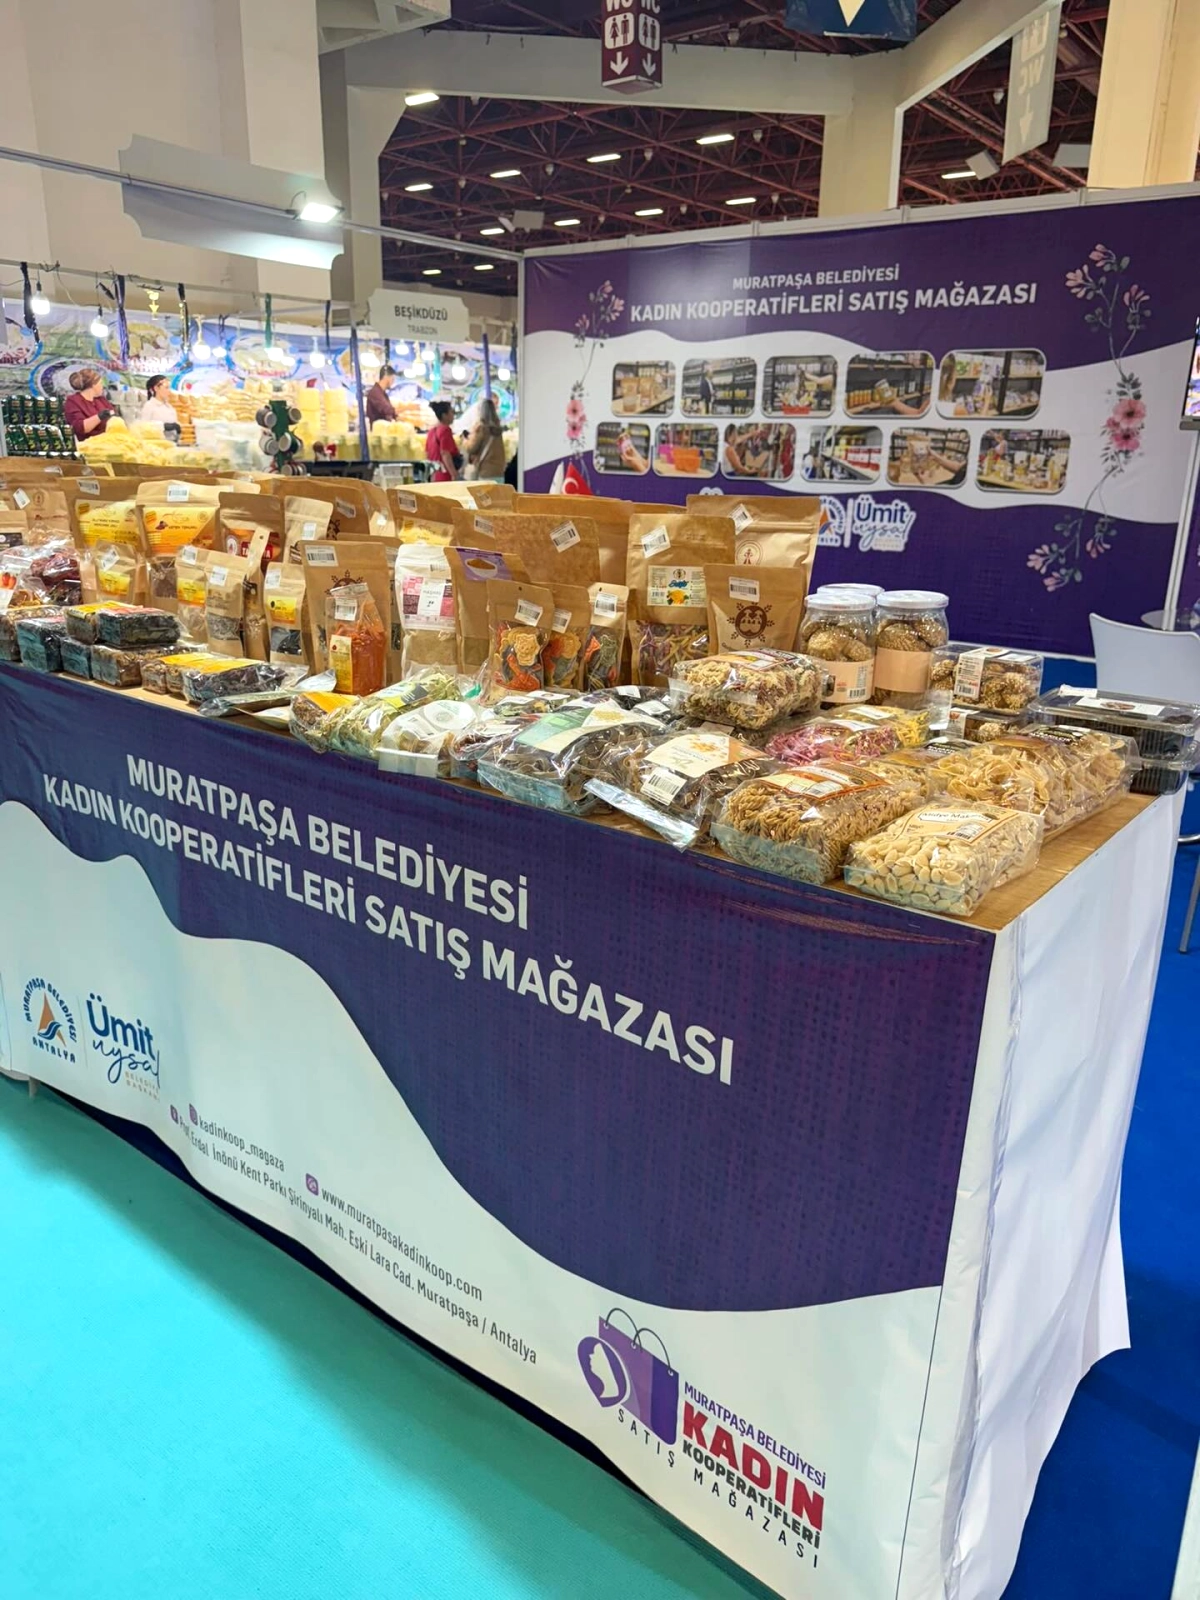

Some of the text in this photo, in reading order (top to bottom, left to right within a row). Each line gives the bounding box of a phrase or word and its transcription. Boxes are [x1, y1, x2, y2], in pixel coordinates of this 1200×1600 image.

[394, 304, 448, 321] BEŞİKDÜZÜ
[630, 281, 1037, 322] KADIN KOOPERATİFLERİ SATIŞ MAĞAZASI
[733, 263, 900, 290] MURATPAŞA BELEDİYESİ
[407, 324, 438, 335] TRABZON
[856, 497, 907, 524] Ümit
[126, 754, 528, 930] MURATPAŞA BELEDİYESİ
[43, 774, 734, 1086] KADIN KOOPERATİFLERİ SATIŞ MAĞAZASI
[32, 1036, 76, 1064] ANTALYA
[86, 993, 156, 1061] Ümit
[199, 1115, 284, 1172] kadinkoop_magaza
[212, 1142, 238, 1171] İnönü
[240, 1160, 261, 1183] Kent
[263, 1172, 286, 1198] Parkı
[288, 1187, 323, 1224] Şirinyalı
[325, 1213, 347, 1241] Mah.
[349, 1229, 368, 1255] Eski
[370, 1244, 391, 1272] Lara
[392, 1262, 414, 1290] Cad.
[417, 1279, 479, 1327] Muratpaşa
[490, 1322, 537, 1364] Antalya
[322, 1189, 482, 1301] www.muratpasakadinkoop.com
[683, 1400, 824, 1531] KADIN
[684, 1381, 826, 1490] MURATPAŞA BELEDİYESİ
[618, 1408, 818, 1568] SATIŞ MAĞAZASI
[683, 1439, 820, 1549] KOOPERATİFLERİ
